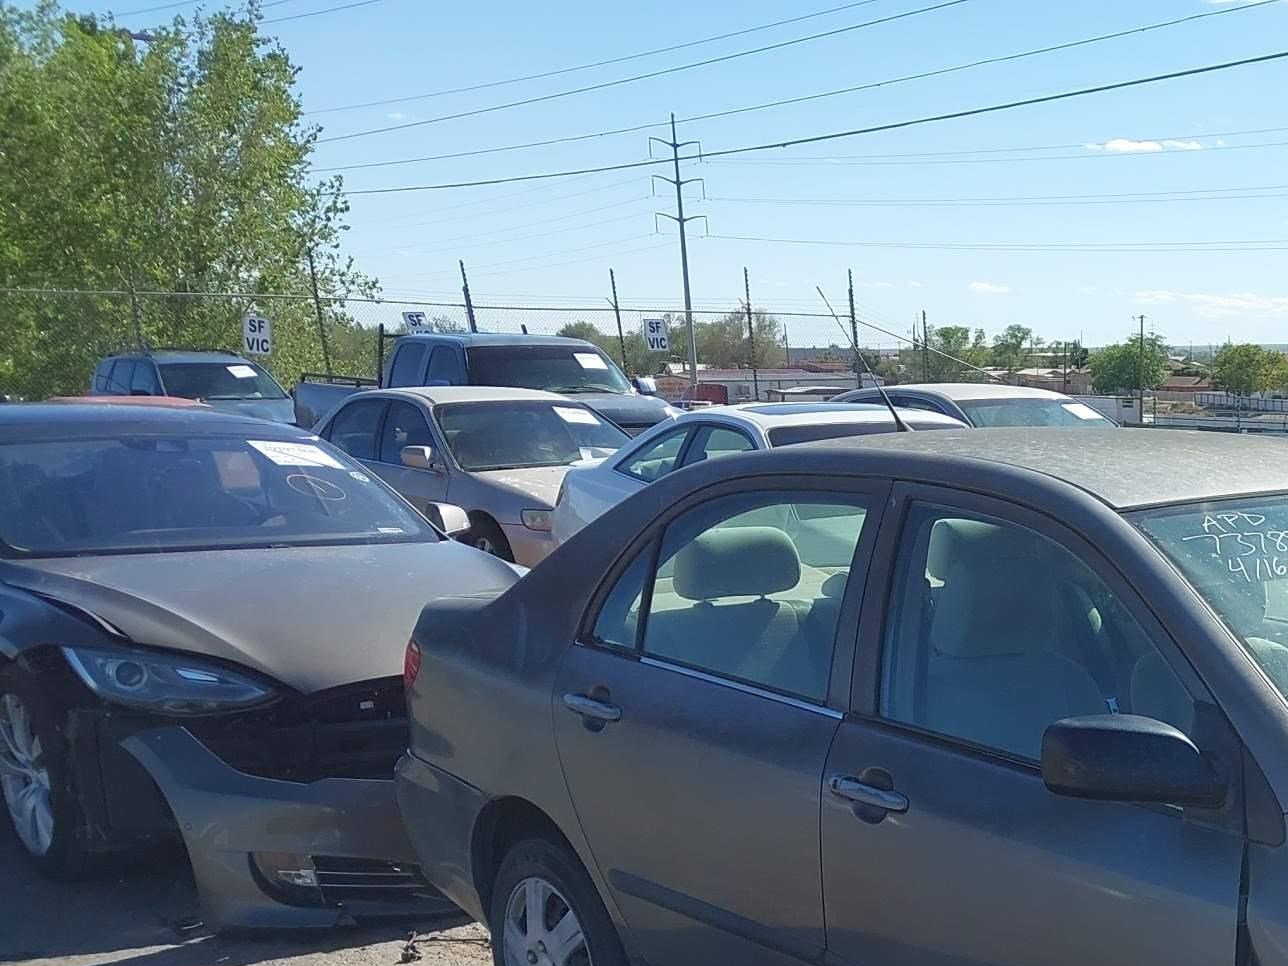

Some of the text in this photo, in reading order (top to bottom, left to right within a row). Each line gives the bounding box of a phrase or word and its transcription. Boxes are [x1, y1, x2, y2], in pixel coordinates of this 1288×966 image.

[248, 319, 265, 334] SF
[408, 314, 423, 327] SF
[648, 321, 661, 333] SF
[246, 337, 270, 353] VIC
[648, 336, 667, 350] VIC
[1202, 511, 1266, 533] APD
